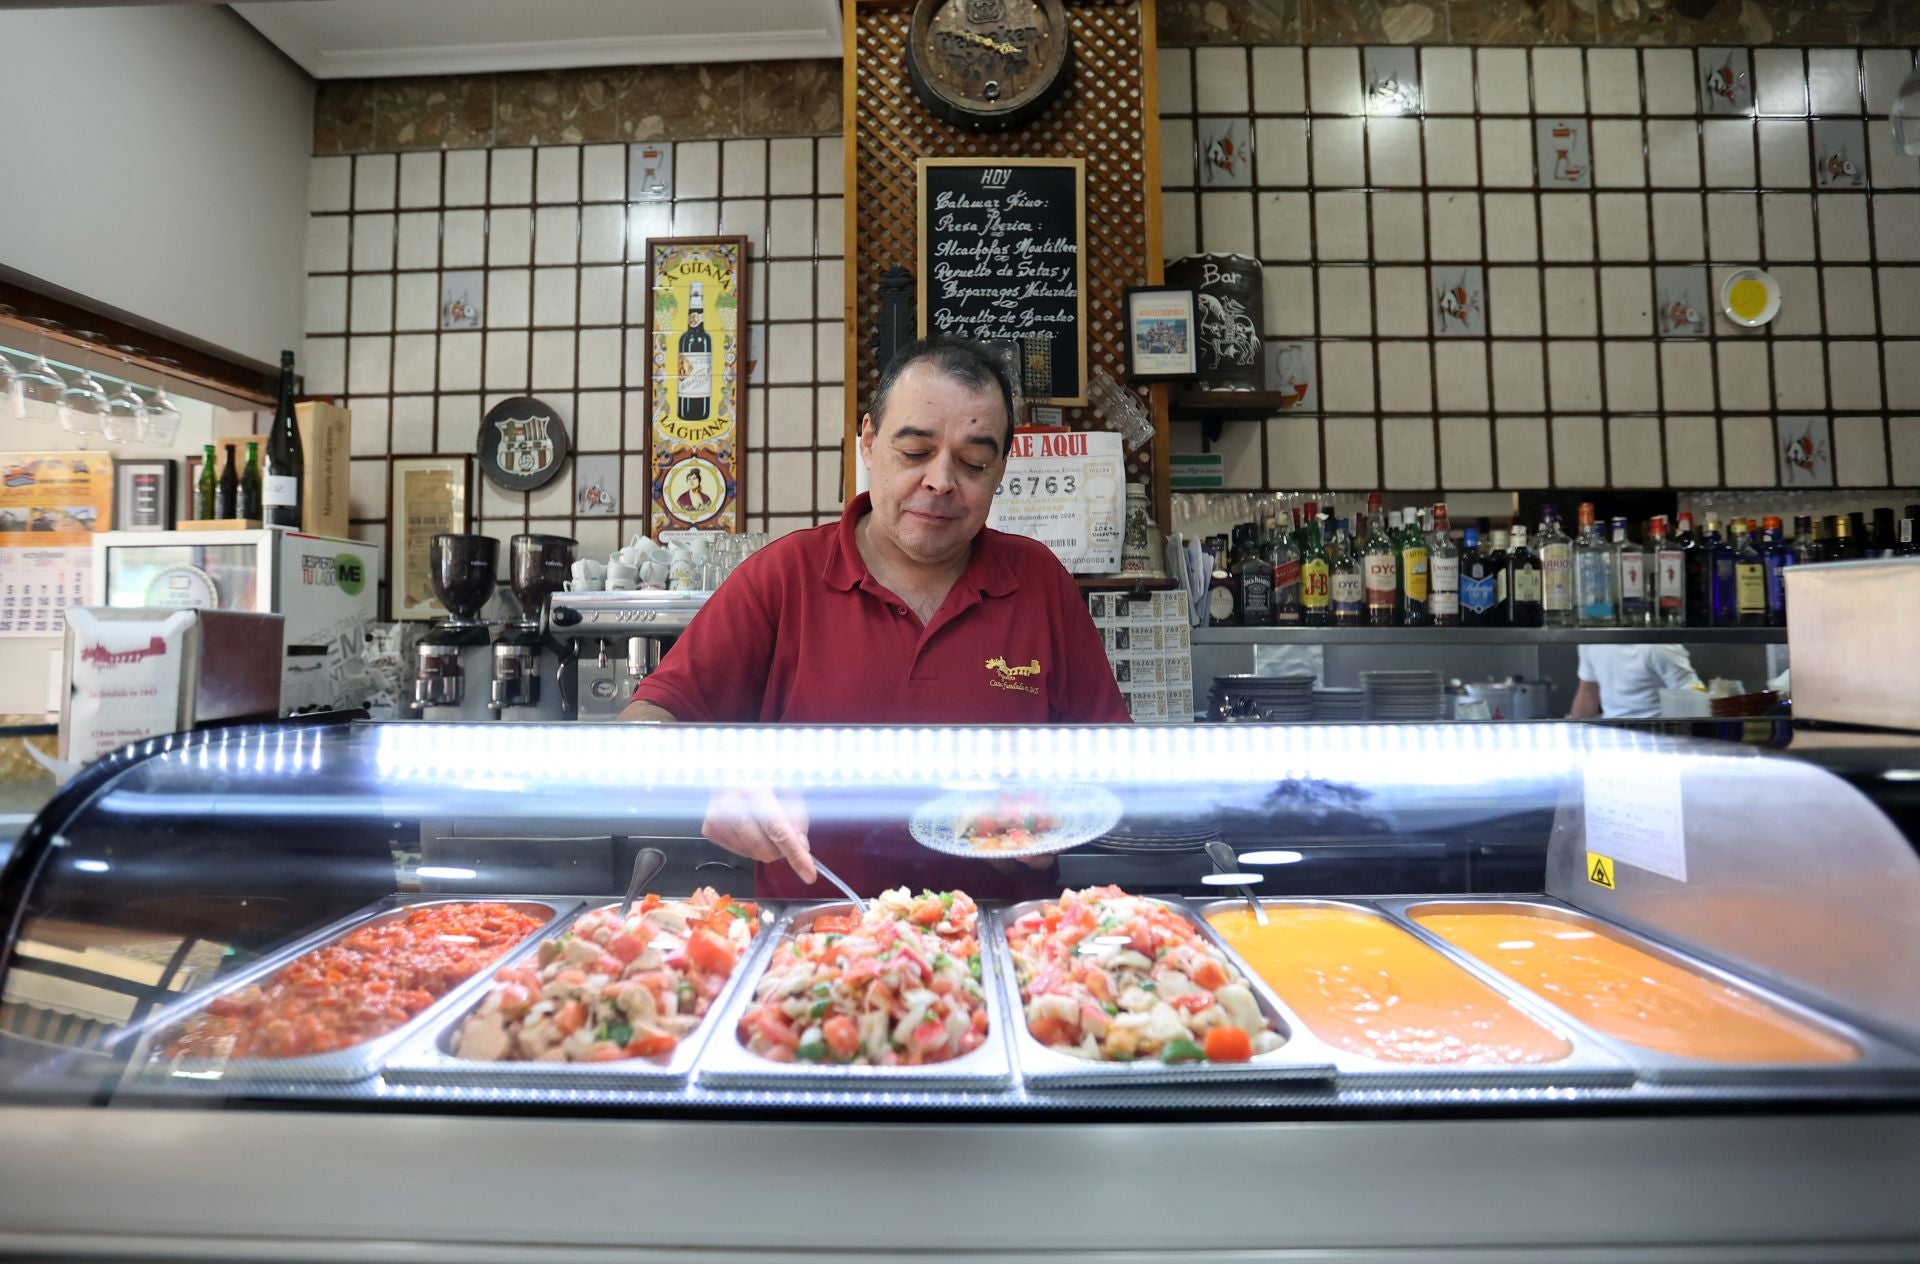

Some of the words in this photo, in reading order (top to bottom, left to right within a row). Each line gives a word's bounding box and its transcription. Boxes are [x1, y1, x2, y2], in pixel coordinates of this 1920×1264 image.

[980, 169, 1012, 185] HOY
[934, 191, 1000, 210] Calamar
[935, 213, 978, 232] Presa
[934, 239, 1010, 264] Alcachofas
[680, 262, 731, 290] GITANA
[934, 262, 992, 281] Revuelto
[996, 263, 1013, 276] de
[1016, 261, 1057, 277] Setas
[1058, 267, 1070, 281] y
[1200, 263, 1242, 289] Bar
[941, 280, 1018, 306] Esparragos
[934, 308, 995, 329] Revuelto
[999, 310, 1015, 323] de
[1016, 308, 1074, 327] Bacalao
[659, 415, 674, 434] LA
[677, 417, 729, 440] GITANA
[1010, 435, 1034, 458] AE
[1041, 434, 1088, 457] AQUI
[1018, 514, 1048, 522] diciembre
[302, 554, 336, 569] DESPIERTA
[1371, 564, 1396, 574] DYC
[302, 568, 314, 585] TU
[314, 569, 336, 586] LADO
[339, 565, 361, 582] ME
